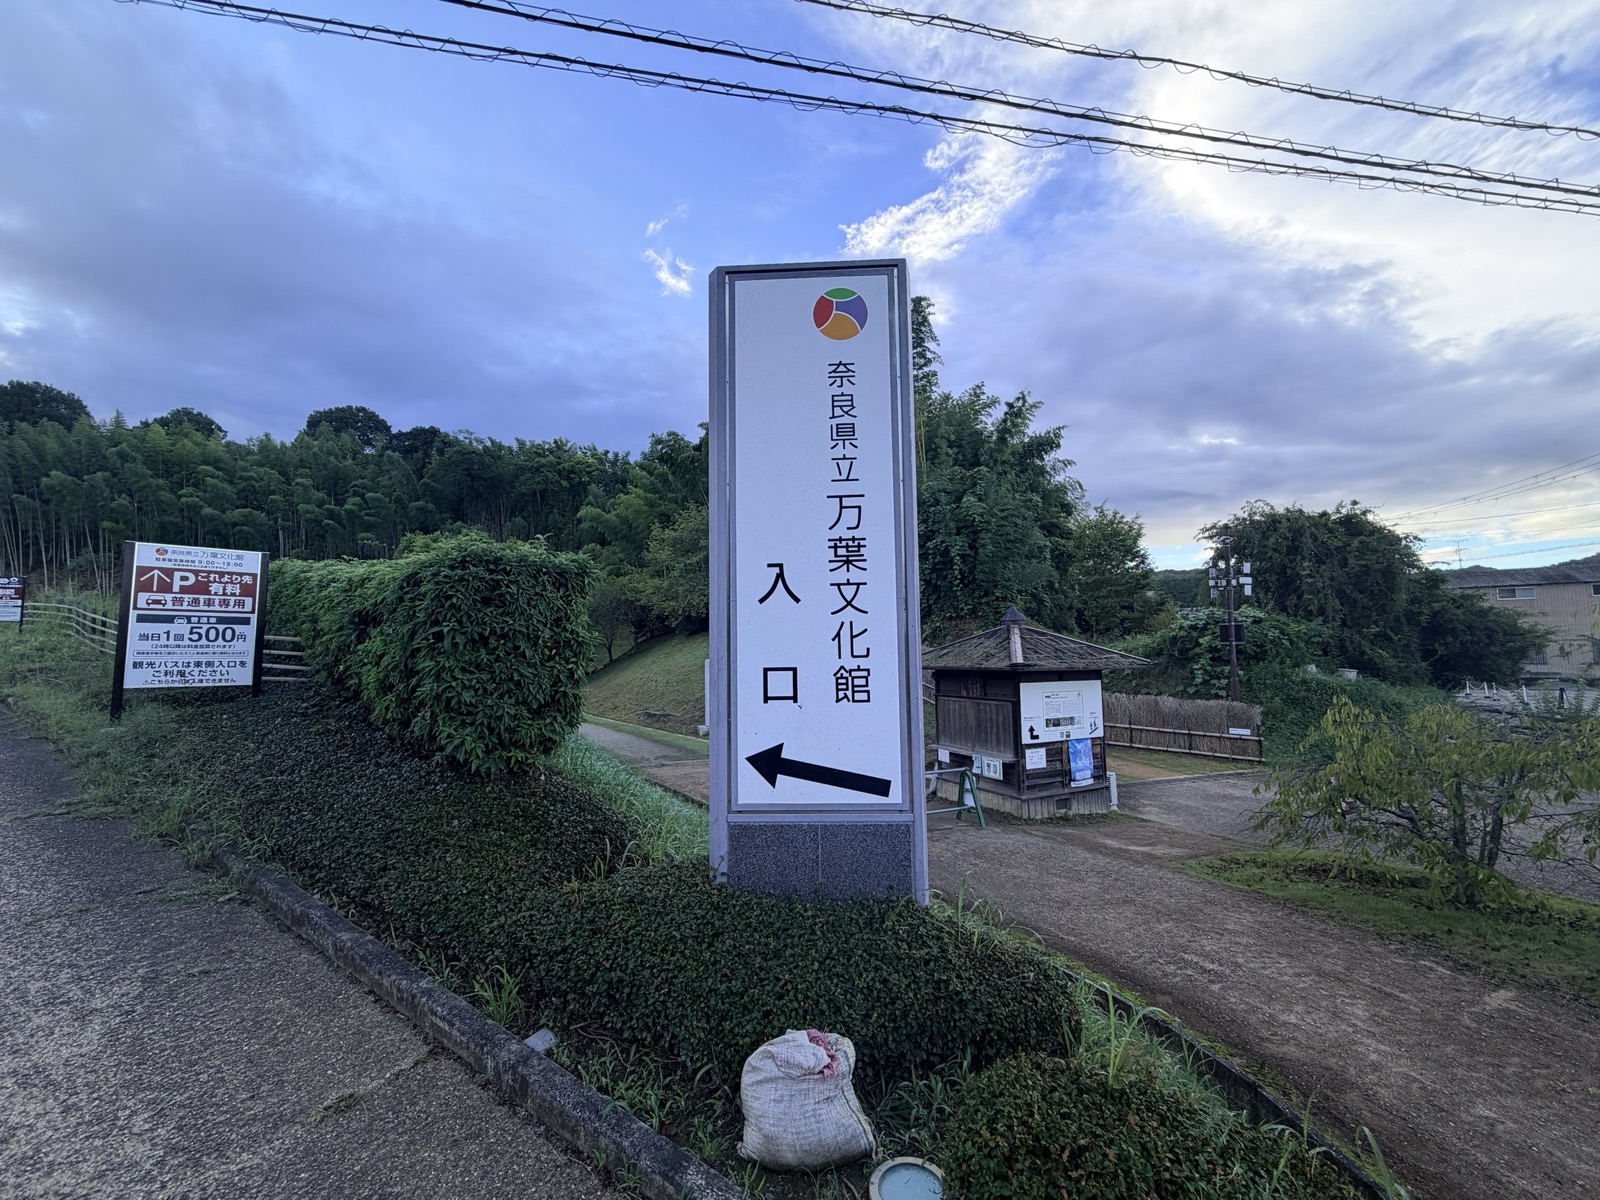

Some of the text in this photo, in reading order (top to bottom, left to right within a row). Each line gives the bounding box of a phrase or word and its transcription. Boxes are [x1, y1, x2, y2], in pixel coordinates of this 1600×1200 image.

[826, 361, 871, 704] 奈良県立万葉文化館
[171, 549, 244, 561] 奈良県立万葉文化館
[173, 571, 195, 592] P
[198, 572, 253, 584] これより先
[209, 582, 241, 595] 有料
[171, 596, 245, 609] 普通車専用
[758, 562, 801, 704] 入口
[132, 660, 247, 669] 観光バスは東側入口を
[152, 669, 230, 678] ご利用ください
